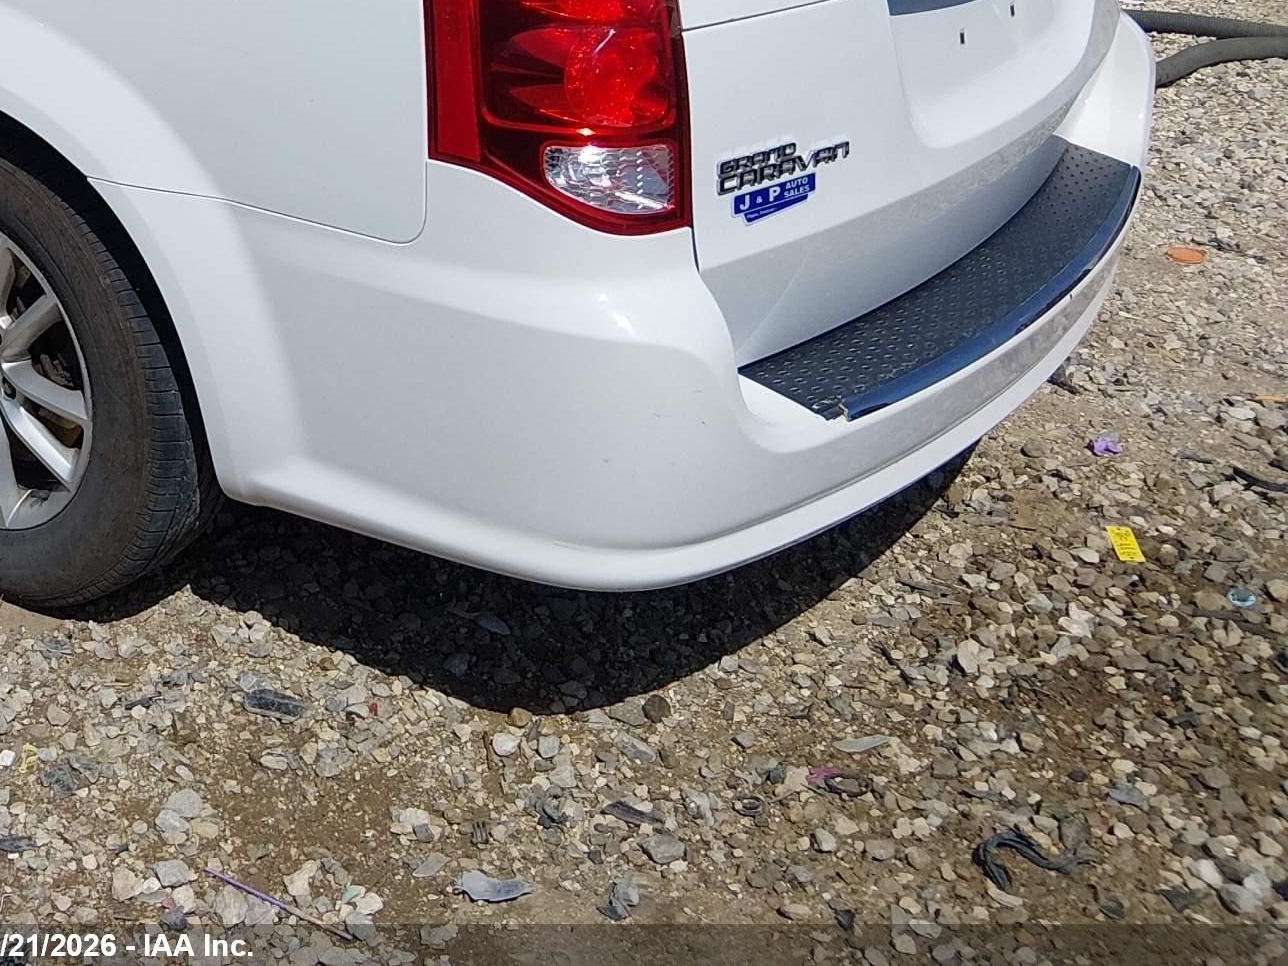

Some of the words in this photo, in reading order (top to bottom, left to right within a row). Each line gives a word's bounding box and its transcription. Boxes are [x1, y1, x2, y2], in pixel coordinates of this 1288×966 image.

[717, 142, 796, 176] GRAND
[717, 141, 850, 196] CARAVAN
[784, 184, 810, 198] SALES
[785, 176, 809, 190] AUTO
[739, 194, 751, 211] J
[756, 195, 763, 204] &
[768, 186, 781, 202] P
